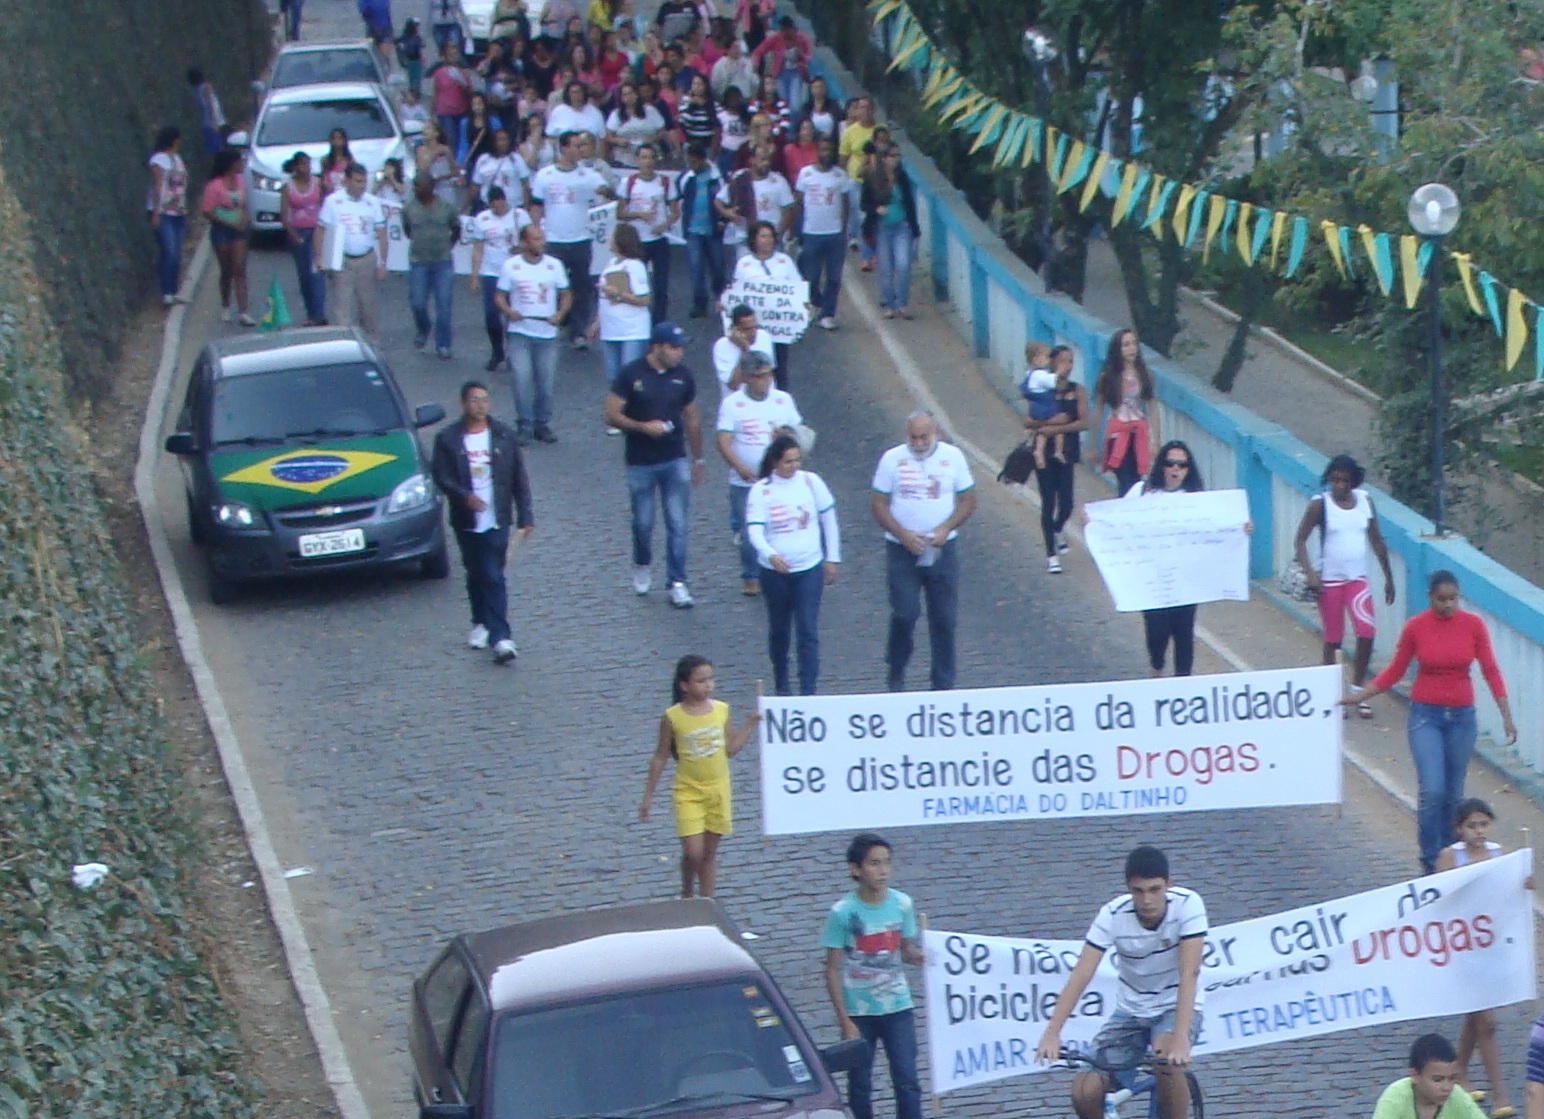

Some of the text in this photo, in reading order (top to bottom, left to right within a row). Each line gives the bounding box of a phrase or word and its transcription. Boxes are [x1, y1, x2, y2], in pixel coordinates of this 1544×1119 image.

[728, 294, 792, 307] PARTE DA
[743, 282, 794, 295] FAZEMOS
[762, 310, 804, 322] CONTRA
[766, 681, 1332, 744] Não se distancia da realidade,
[783, 742, 1276, 794] se distancie das Drogas.
[1039, 793, 1067, 813] DO
[1081, 786, 1187, 811] DALTINHO
[944, 936, 992, 975] Se
[1270, 907, 1349, 956] cair
[945, 983, 1104, 1025] biciclea
[952, 1038, 1028, 1080] AMAR
[1219, 985, 1396, 1040] TERAPÊUTICA
